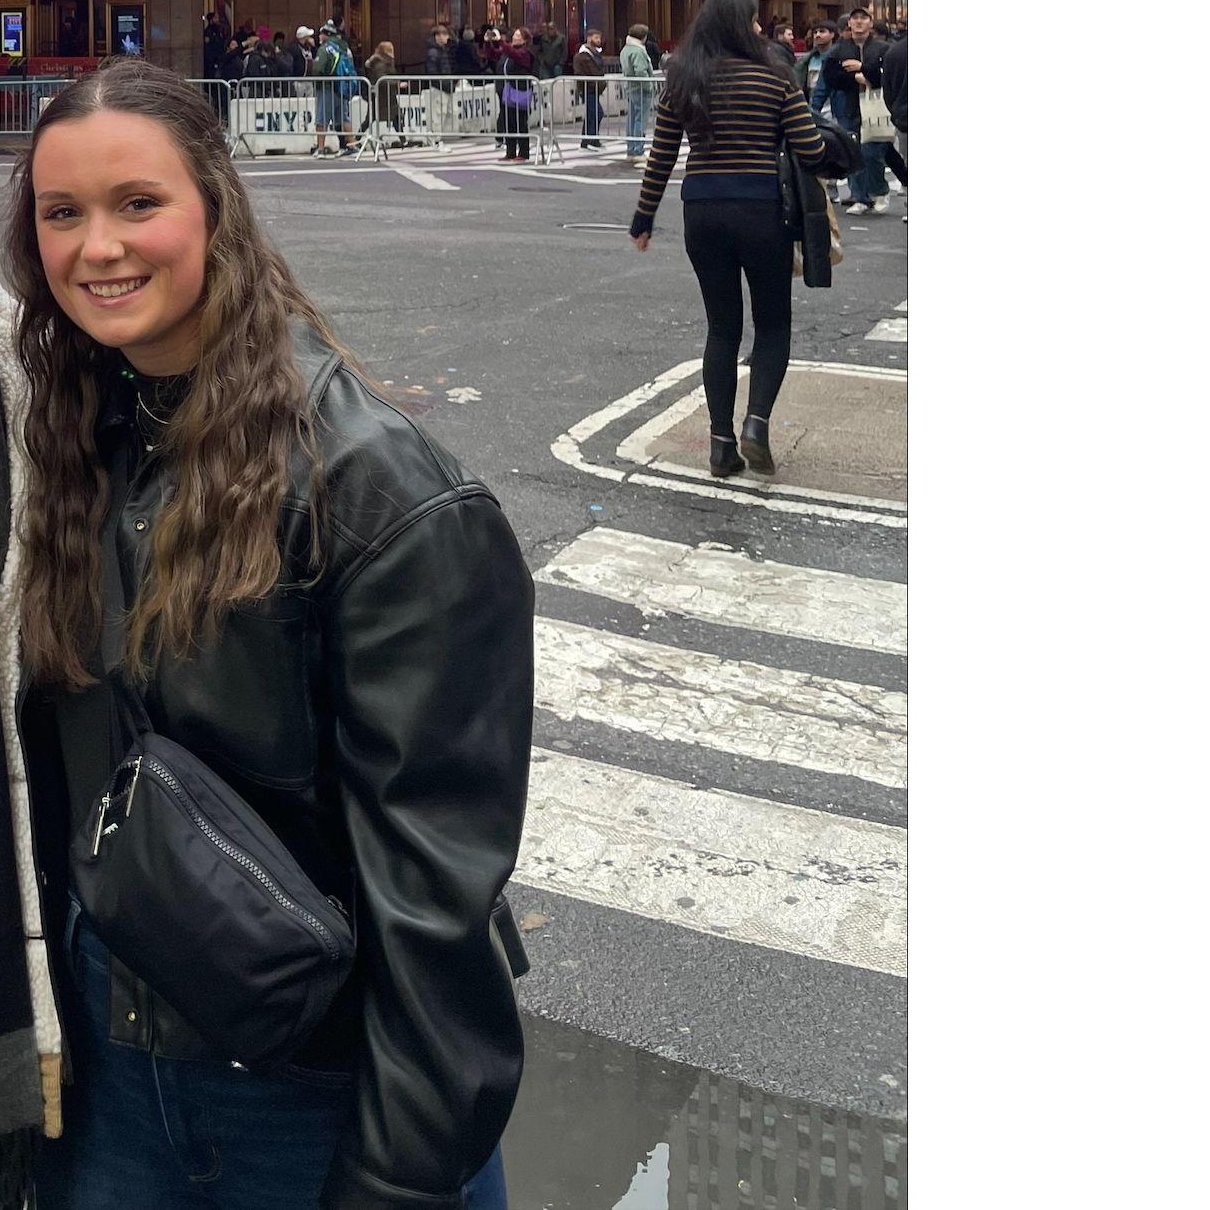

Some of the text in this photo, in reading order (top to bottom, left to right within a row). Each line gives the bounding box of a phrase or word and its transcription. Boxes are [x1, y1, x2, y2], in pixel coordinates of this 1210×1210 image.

[40, 63, 83, 71] Christas
[398, 107, 422, 127] YPD
[461, 97, 487, 120] NYPD
[266, 111, 313, 132] NYP
